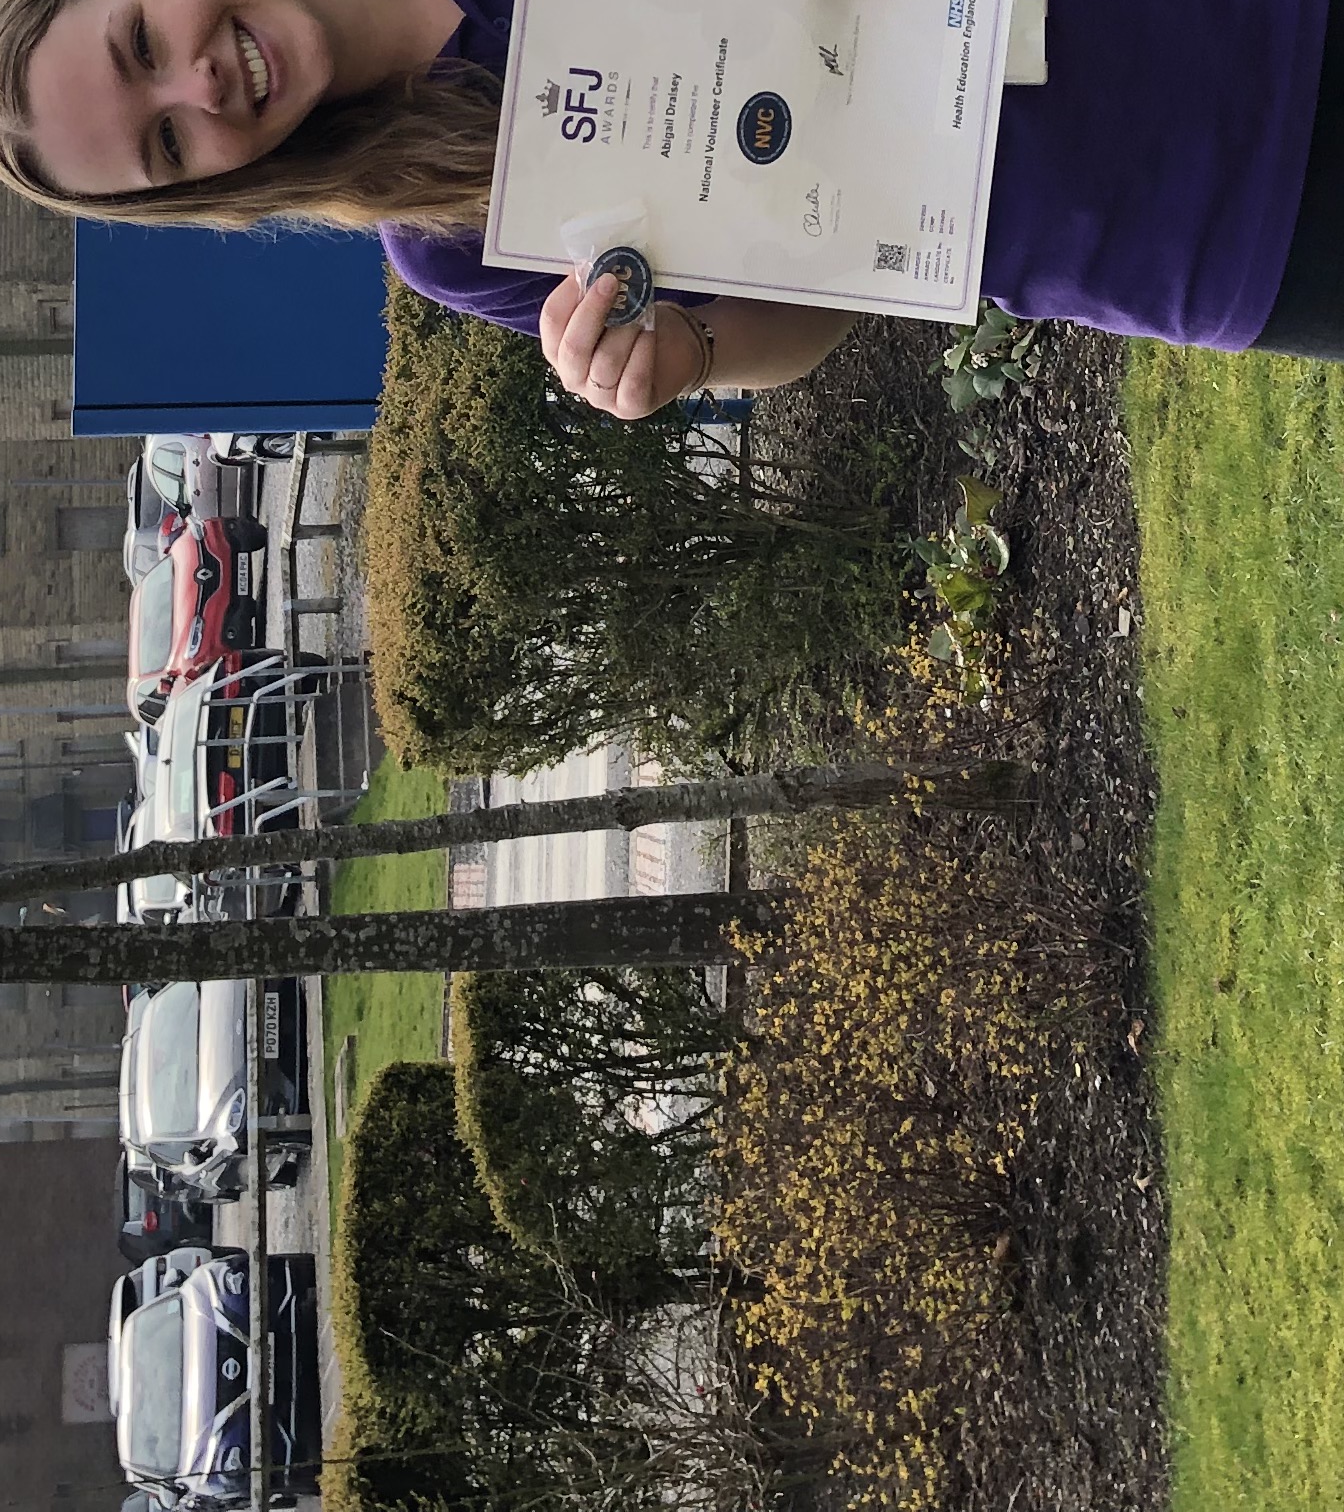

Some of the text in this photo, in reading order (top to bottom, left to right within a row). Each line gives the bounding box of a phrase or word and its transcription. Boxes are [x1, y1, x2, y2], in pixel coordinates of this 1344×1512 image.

[956, 42, 970, 92] Education
[561, 68, 602, 143] SFJ
[600, 71, 618, 145] AWARDS
[698, 38, 729, 202] National Volunteer Certificate
[754, 108, 774, 148] NVC
[952, 94, 965, 129] Health
[660, 118, 674, 158] Abigail
[266, 998, 276, 1052] PO70 KZH
